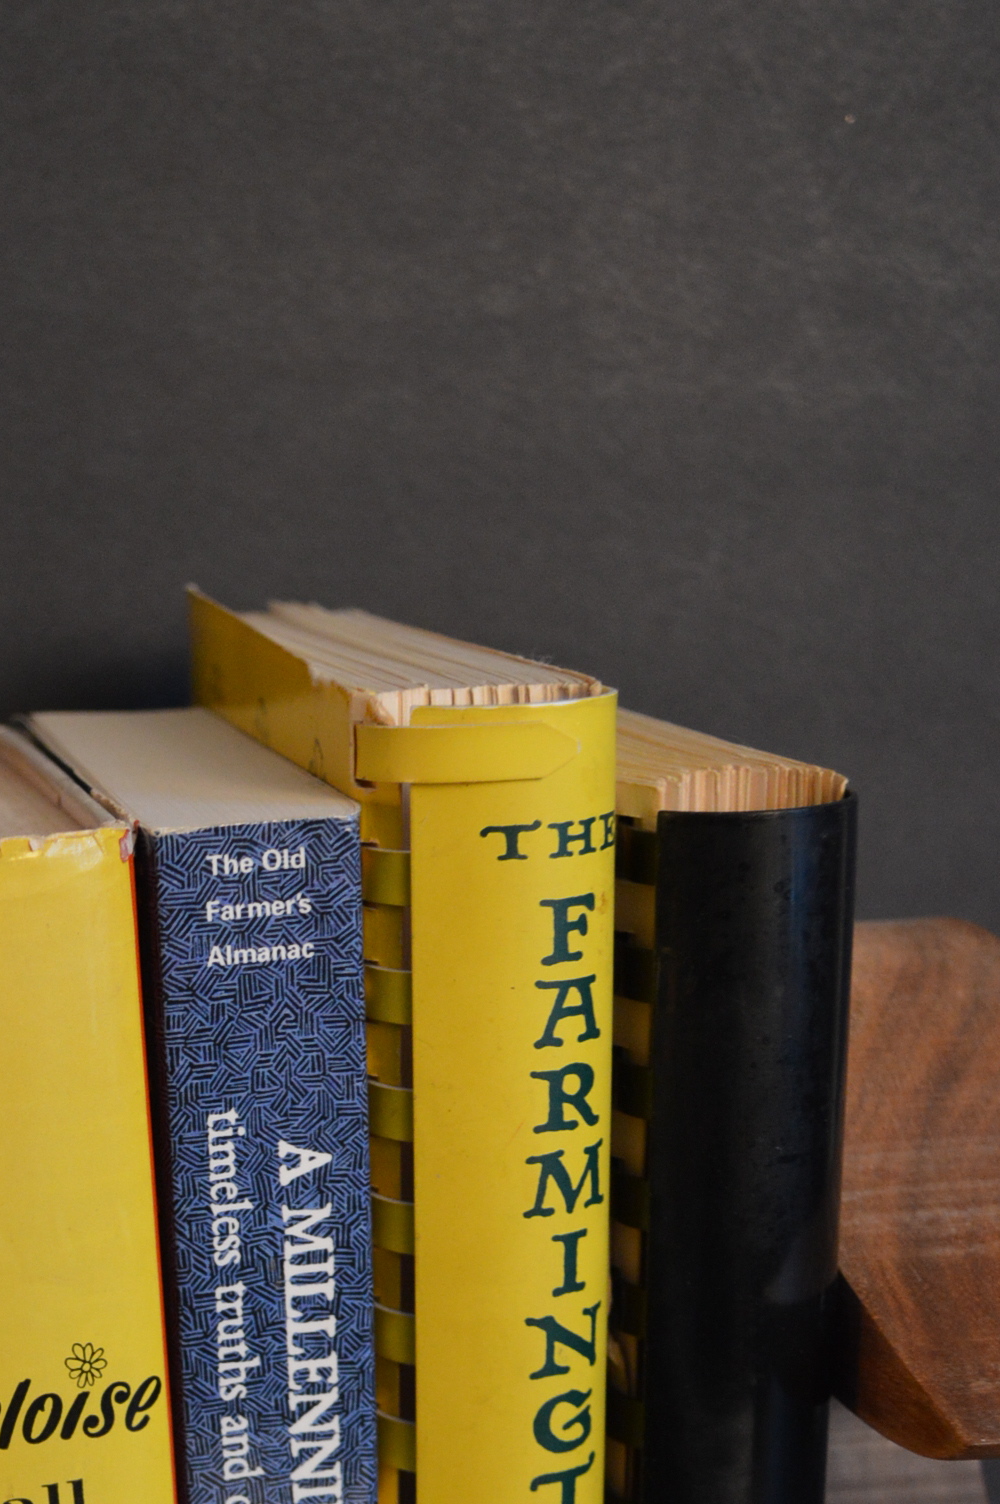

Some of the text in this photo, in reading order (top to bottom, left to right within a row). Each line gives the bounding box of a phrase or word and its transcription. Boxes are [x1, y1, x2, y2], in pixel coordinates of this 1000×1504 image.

[479, 810, 616, 861] THE
[205, 847, 306, 878] The Old
[205, 892, 312, 922] Farmer's
[206, 940, 315, 968] Almanac
[207, 1107, 254, 1269] timeless
[278, 1139, 333, 1188] A
[214, 1280, 262, 1402] truths
[221, 1413, 265, 1482] and
